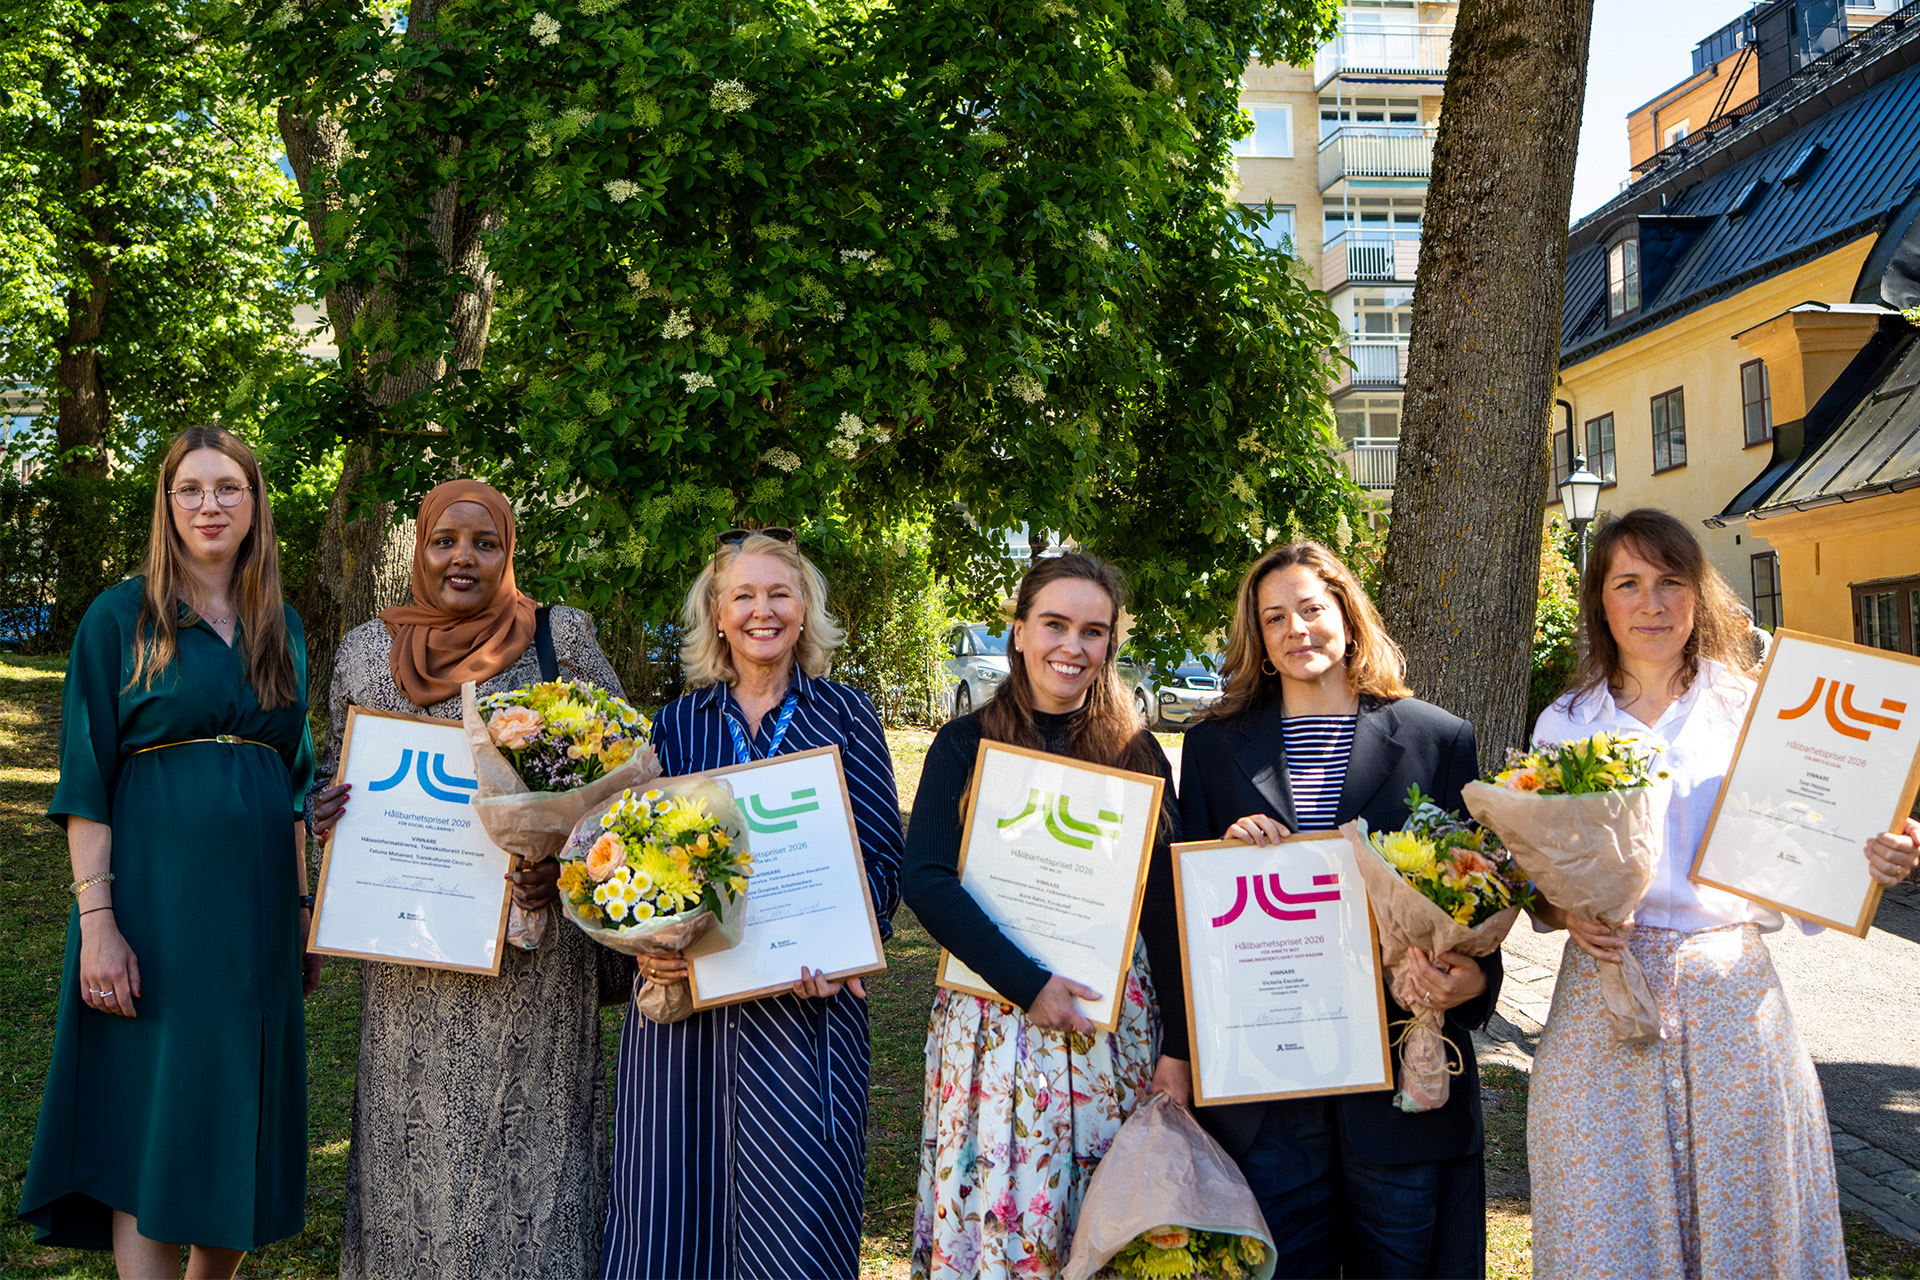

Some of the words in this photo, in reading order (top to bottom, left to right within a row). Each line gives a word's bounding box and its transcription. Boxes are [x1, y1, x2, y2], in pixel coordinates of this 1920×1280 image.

[1847, 756, 1867, 767] 2026
[384, 810, 450, 824] Hållbarhetspriset
[788, 842, 808, 851] 2026
[1011, 850, 1073, 869] Hållbarhetspriset
[1075, 864, 1094, 875] 2026
[1235, 939, 1302, 949] Hållbarhetspriset
[1304, 935, 1325, 944] 2026
